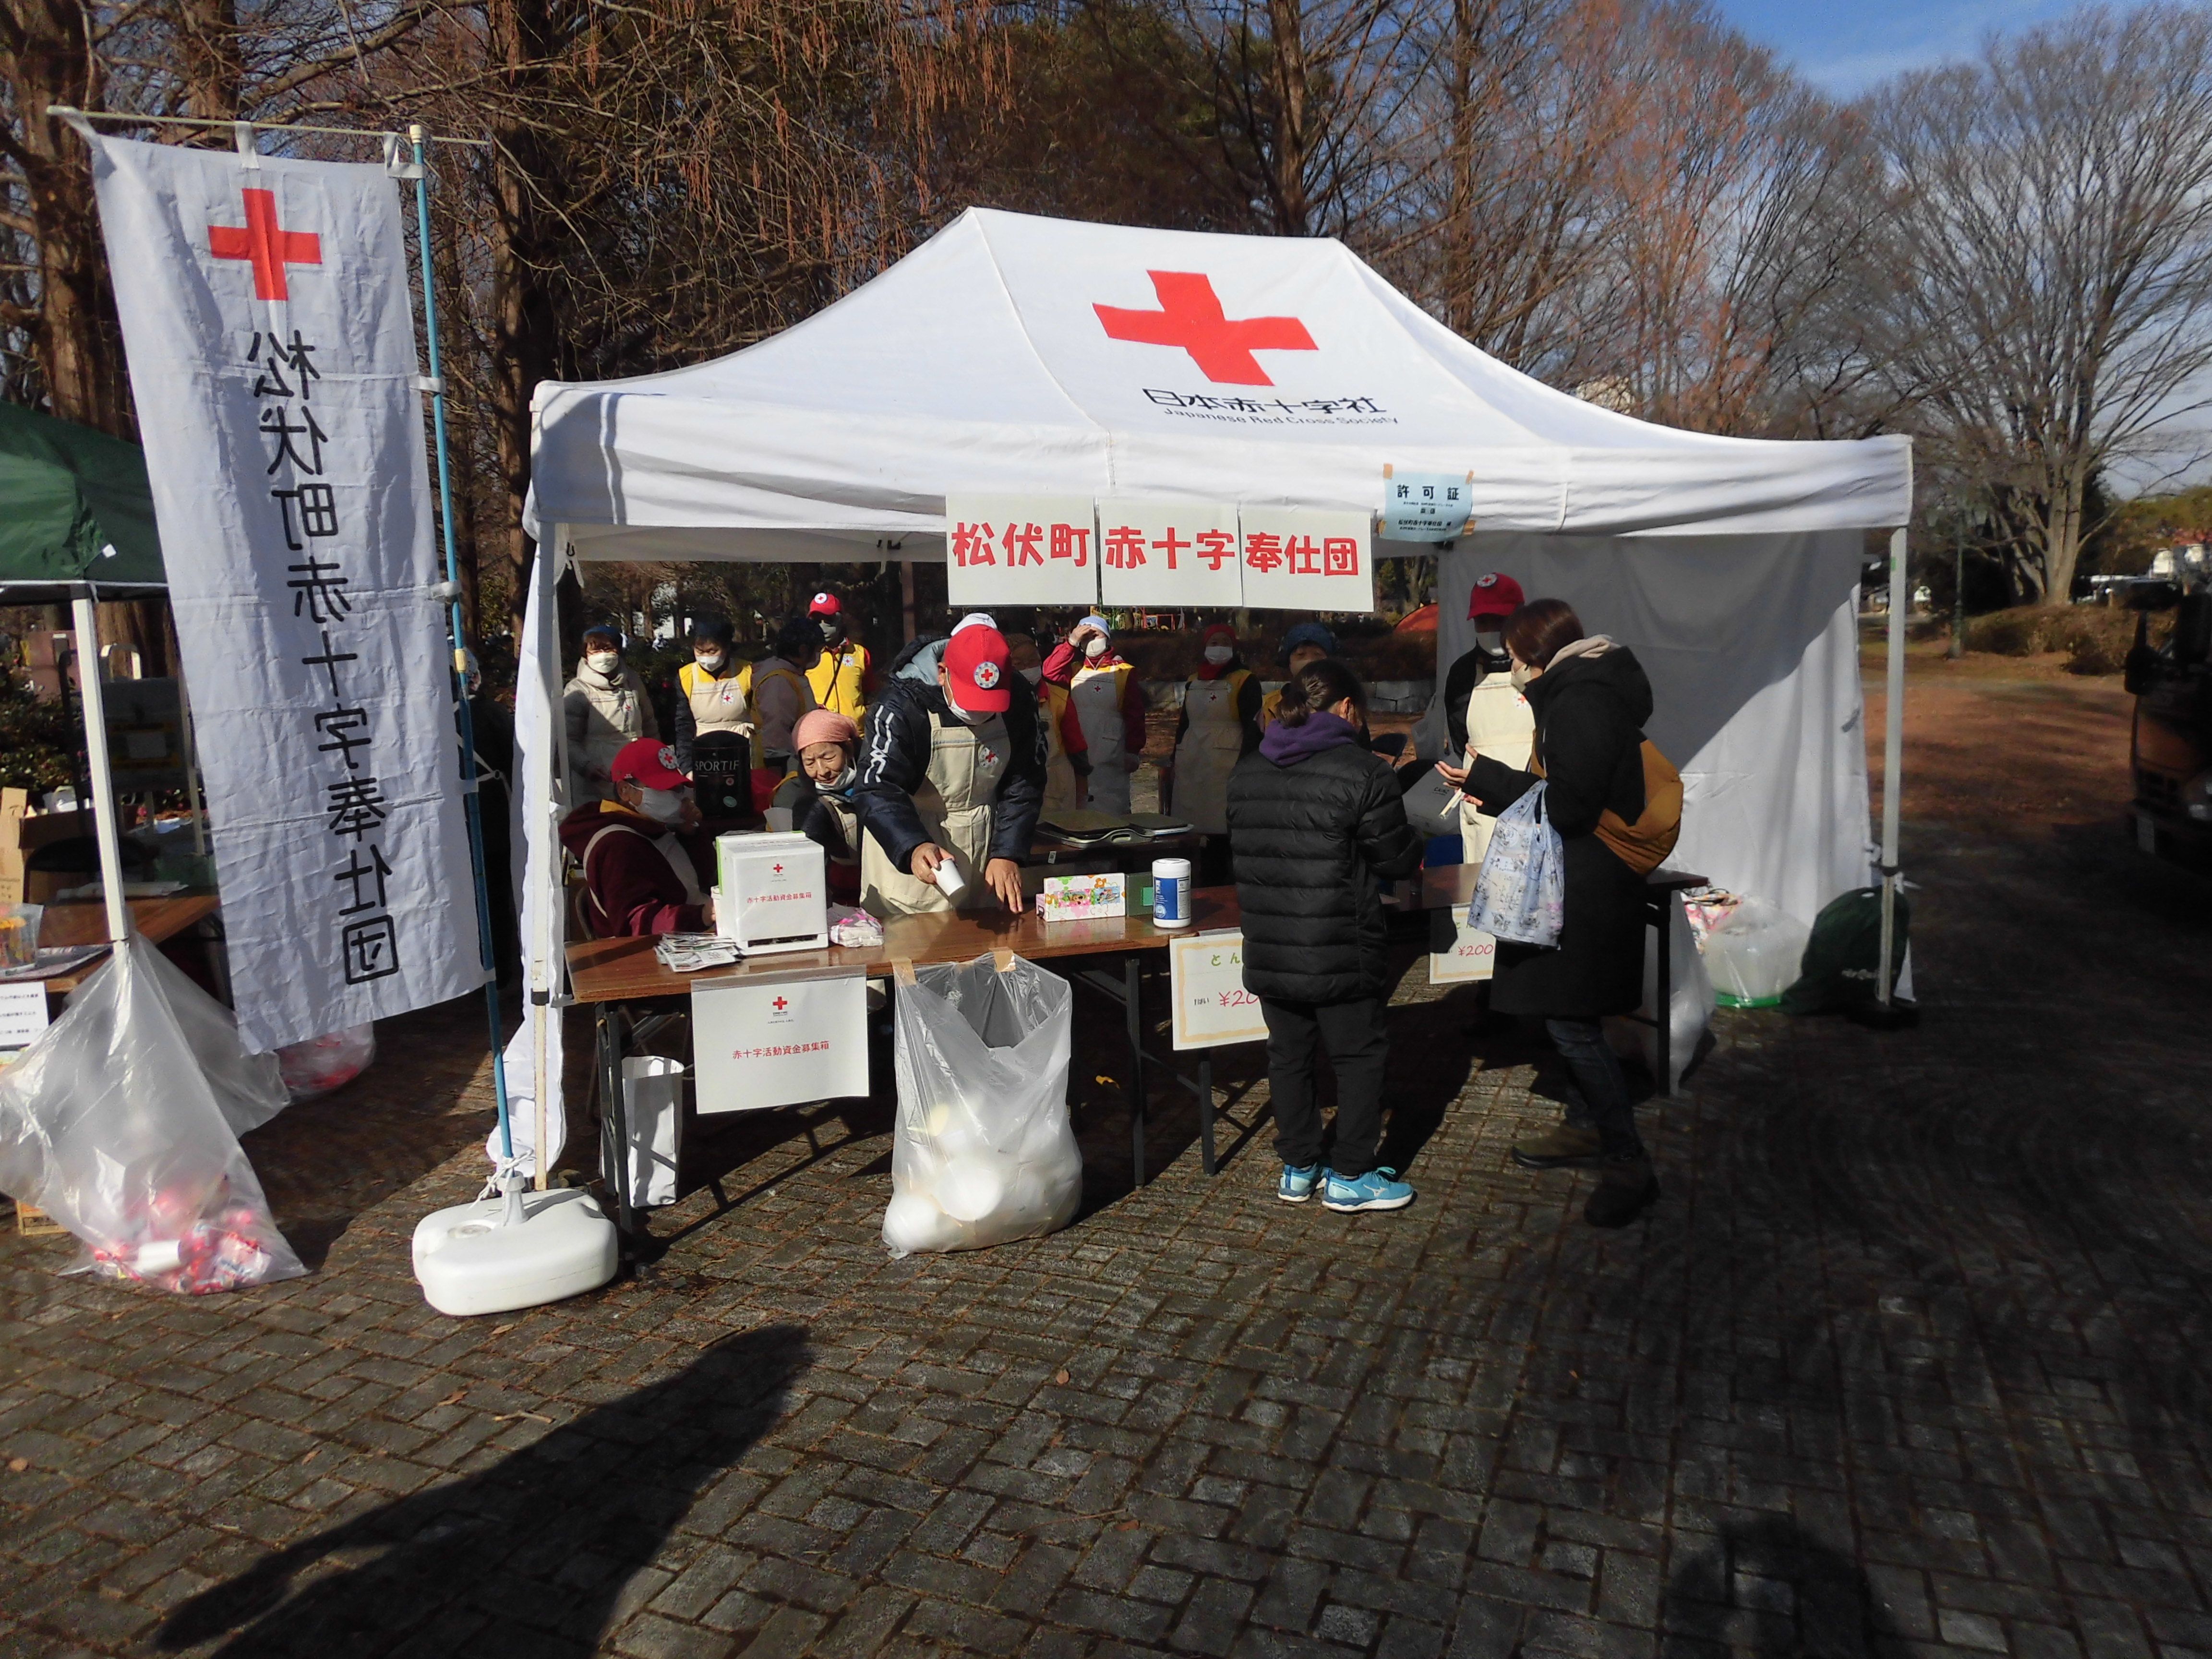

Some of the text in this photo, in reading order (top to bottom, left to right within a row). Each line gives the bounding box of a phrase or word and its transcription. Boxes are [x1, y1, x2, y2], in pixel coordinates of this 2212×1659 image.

[1143, 389, 1387, 414] 日本赤十字社
[1164, 408, 1247, 423] Japanese
[1249, 415, 1284, 424] Red
[1336, 416, 1398, 424] Society
[1397, 484, 1459, 500] 許可証
[951, 522, 1090, 567] 松伏町
[1105, 526, 1236, 571] 赤十字
[1245, 531, 1359, 576] 奉仕団
[695, 760, 740, 771] SPORTIF
[1458, 944, 1495, 956] ¥200
[733, 1040, 830, 1059] 赤十字活動資金募集箱
